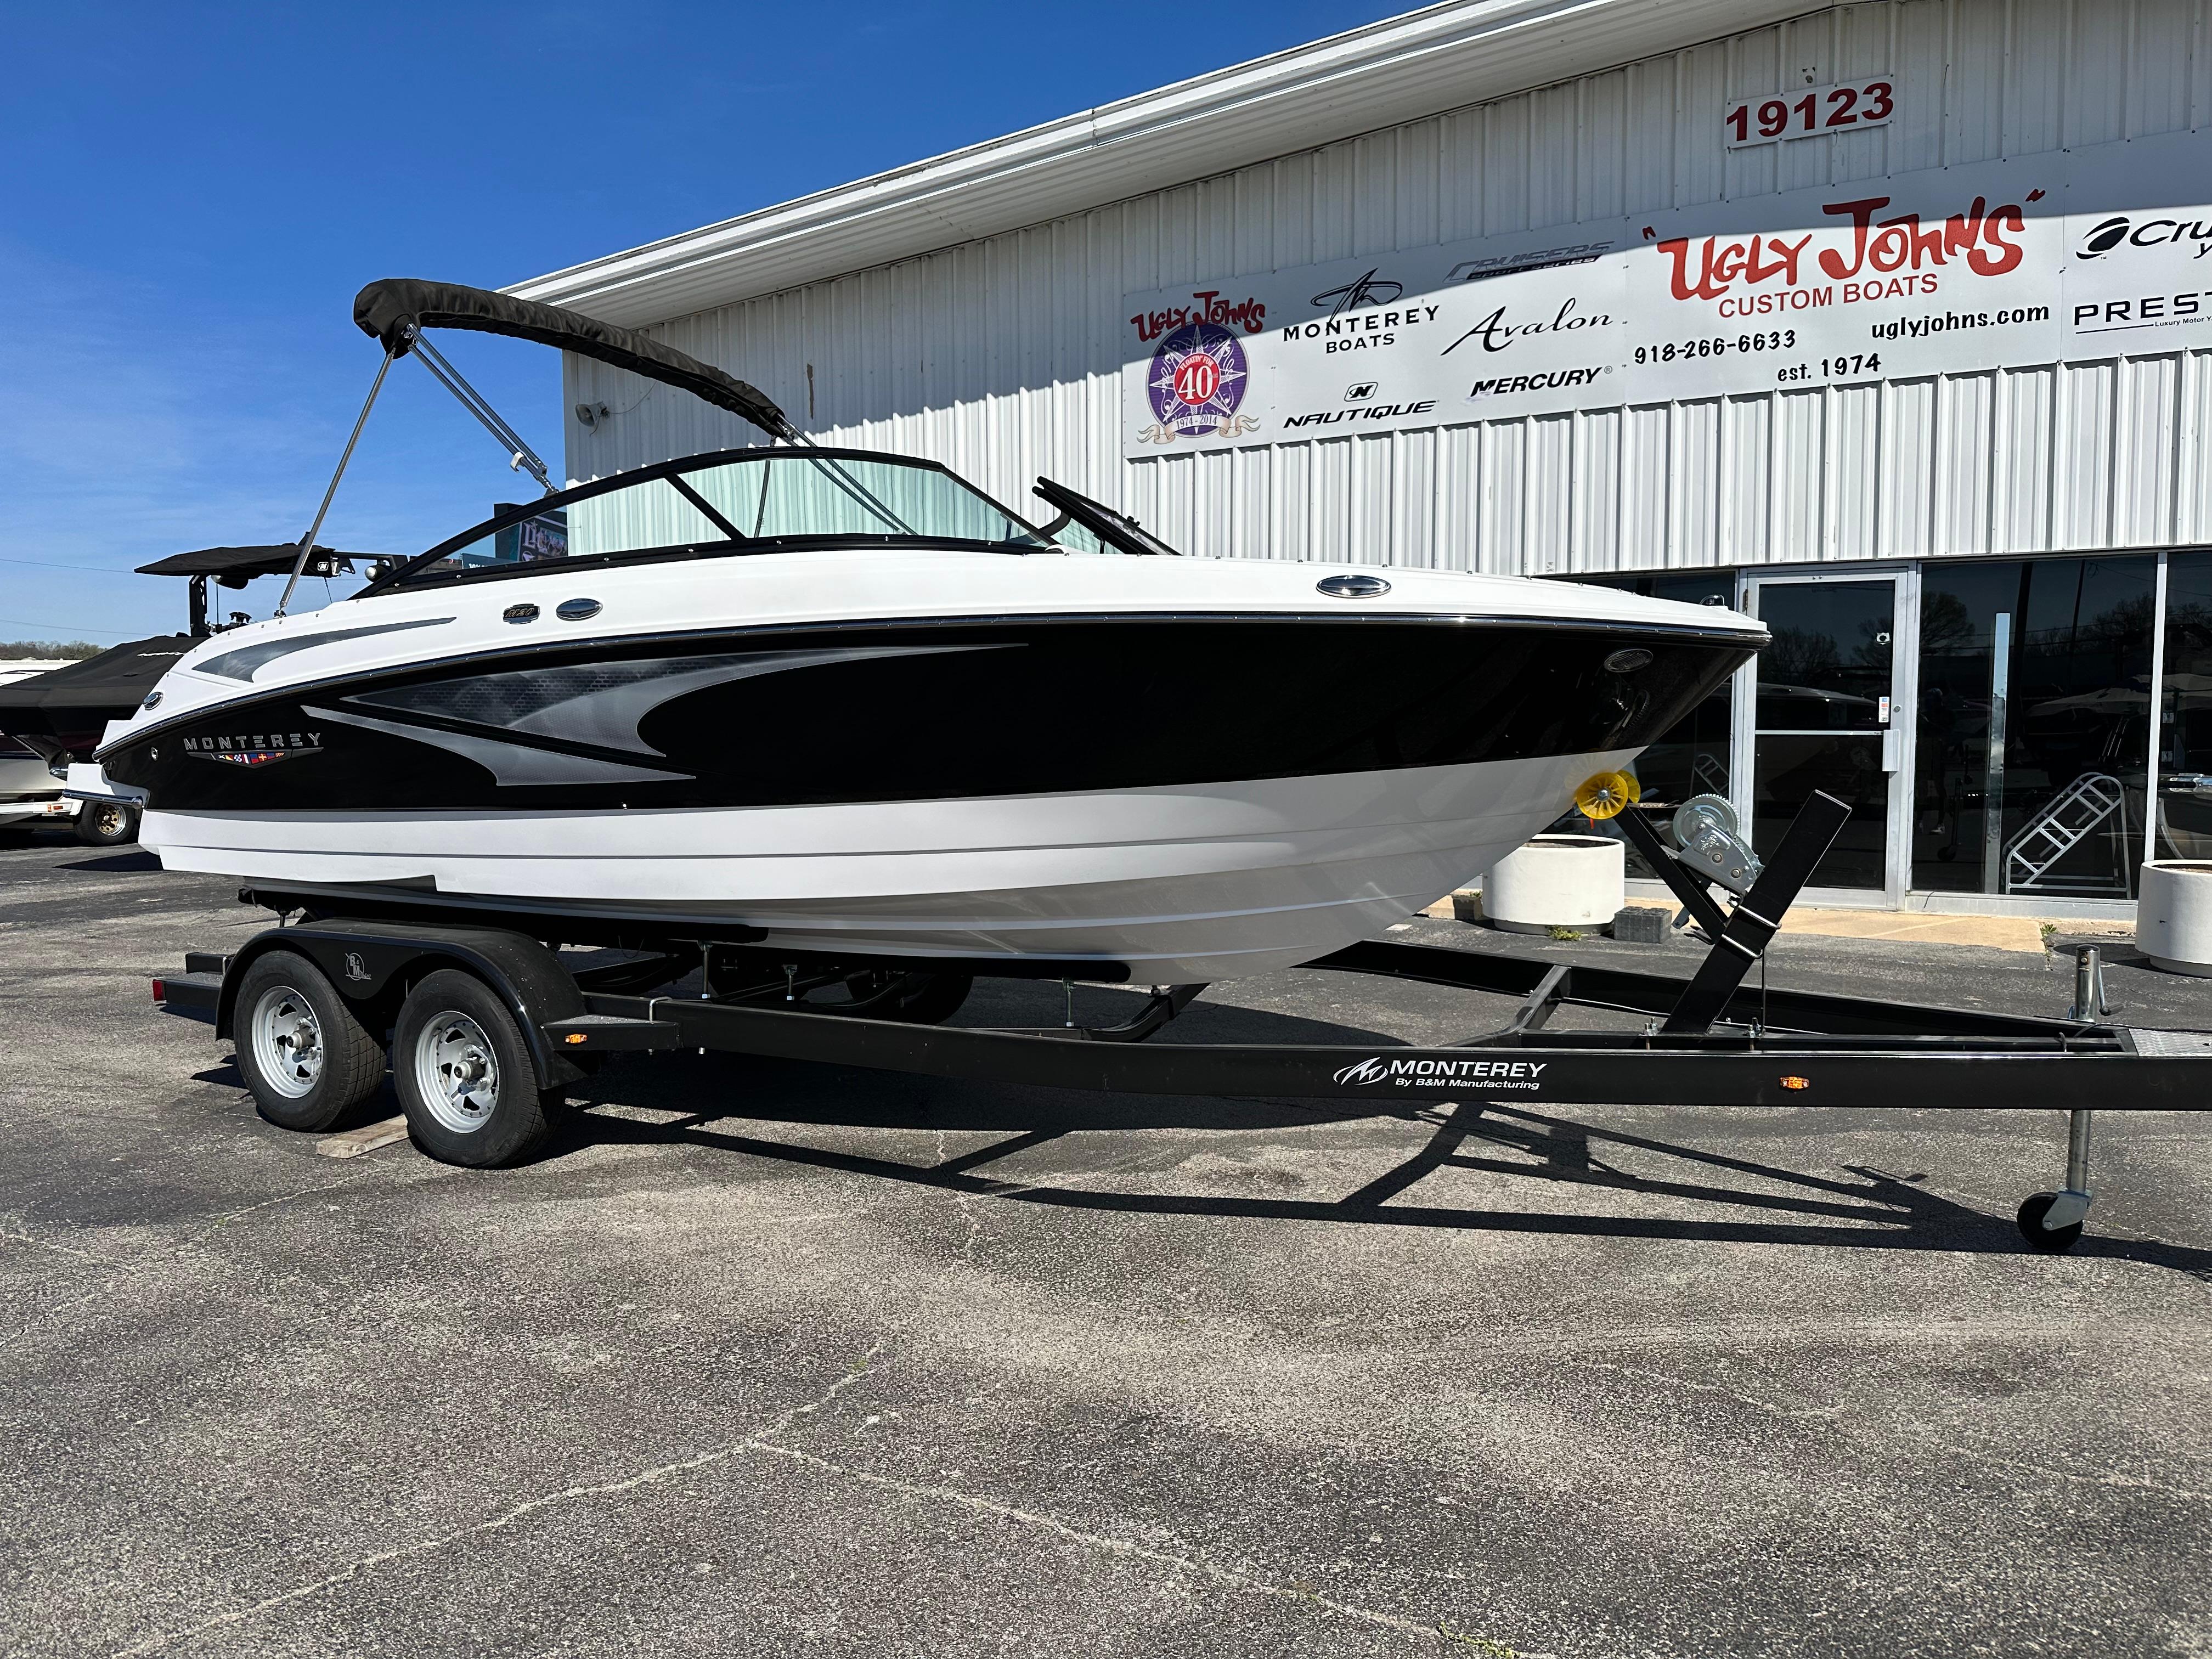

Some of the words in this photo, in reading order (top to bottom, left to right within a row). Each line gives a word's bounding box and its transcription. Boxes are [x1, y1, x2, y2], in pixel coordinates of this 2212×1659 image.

[1726, 82, 1893, 142] 19123
[1442, 241, 1615, 284] CRUISERS
[1719, 286, 1832, 318] CUSTOM
[1843, 273, 1938, 303] BOATS
[1283, 304, 1440, 342] MONTEREY
[1440, 297, 1613, 356] Avalon
[1872, 306, 2049, 340] uglyjohns.com
[1325, 333, 1395, 354] BOATS
[1634, 329, 1796, 364] 918-266-6633
[1178, 365, 1213, 399] 40
[1778, 364, 1812, 381] est.
[1821, 353, 1882, 377] 1974
[1176, 419, 1193, 430] 1974
[1199, 415, 1217, 425] 2014
[1283, 400, 1437, 428] NAUTIQUE
[183, 732, 320, 750] MONTEREY
[1390, 1060, 1548, 1077] MONTEREY
[1395, 1078, 1412, 1087] By
[1415, 1079, 1444, 1087] B&M
[1448, 1079, 1540, 1090] Manufacturing
